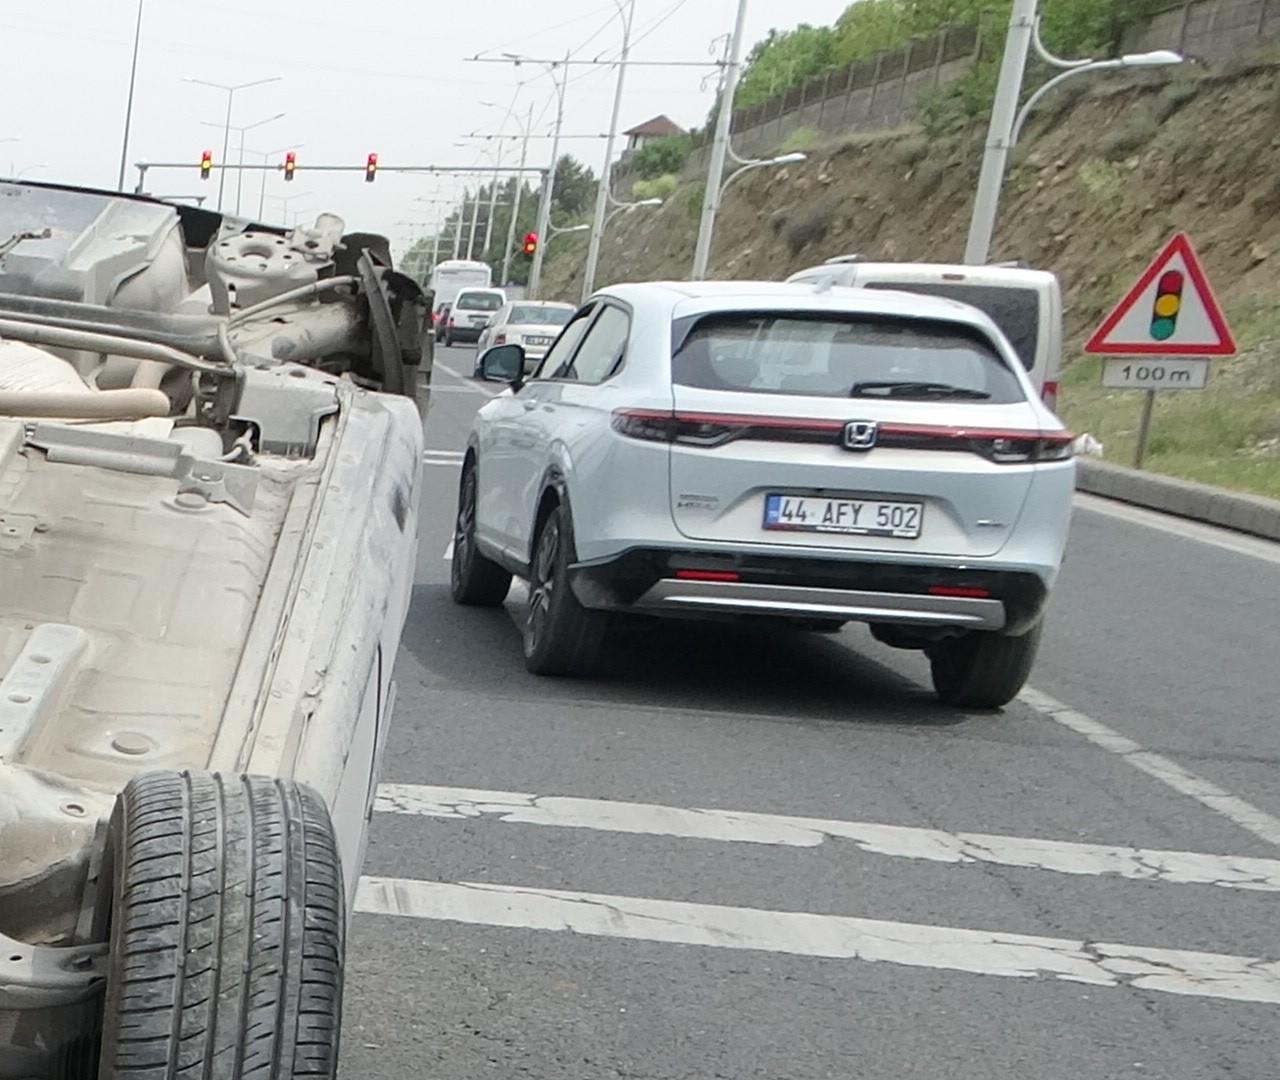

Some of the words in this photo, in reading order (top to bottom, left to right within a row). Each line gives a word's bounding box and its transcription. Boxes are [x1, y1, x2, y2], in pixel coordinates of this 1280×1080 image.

[1121, 365, 1166, 381] 100
[1169, 370, 1191, 381] m
[781, 499, 808, 522] 44
[822, 501, 864, 525] AFY
[876, 505, 918, 529] 502
